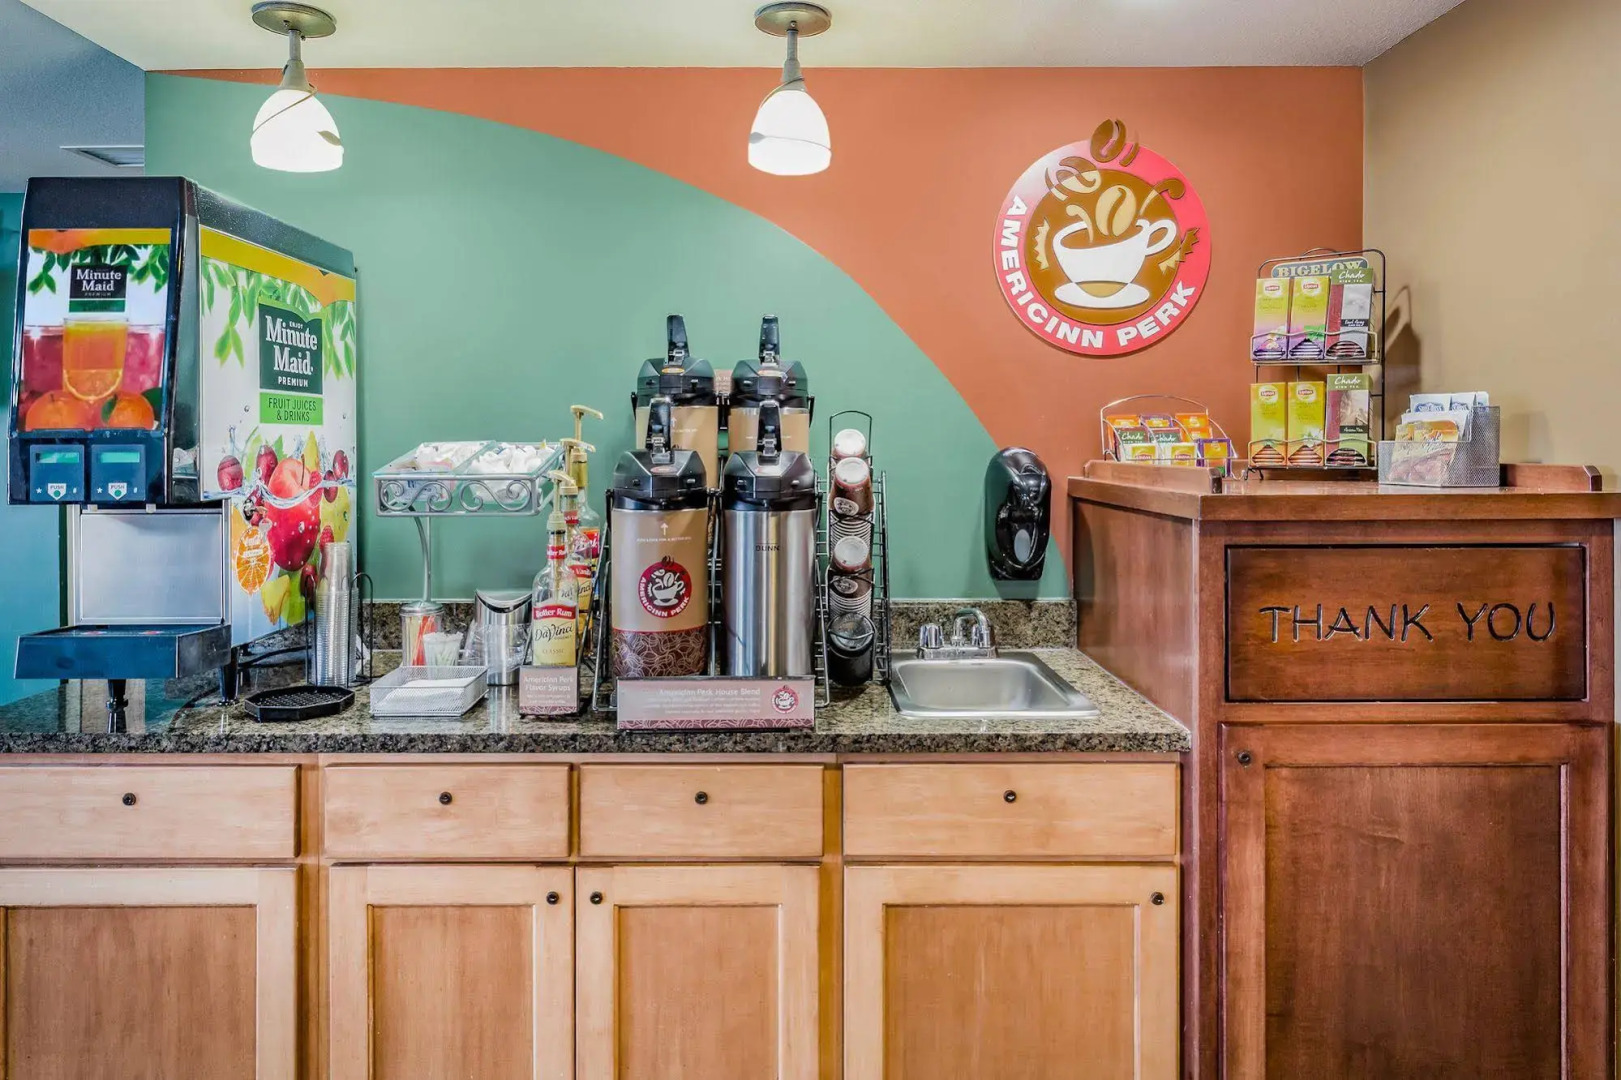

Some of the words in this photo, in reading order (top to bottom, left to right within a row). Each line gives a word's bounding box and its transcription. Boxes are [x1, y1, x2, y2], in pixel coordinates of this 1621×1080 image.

[76, 268, 122, 280] Minute
[1000, 195, 1104, 348] AMERICINN
[1116, 280, 1196, 347] PERK
[82, 280, 115, 291] Maid
[265, 315, 318, 351] Minute
[273, 345, 313, 375] Maid
[277, 376, 309, 387] PREMIUM
[268, 397, 291, 409] FRUIT
[292, 399, 317, 411] JUICES
[276, 410, 282, 421] &
[283, 410, 310, 422] DRINKS
[638, 576, 668, 617] AMERICINN
[670, 596, 690, 616] PERK
[557, 608, 573, 617] Rum
[1258, 603, 1433, 643] THANK
[1456, 602, 1556, 642] YOU
[535, 622, 573, 642] DaVinci
[715, 688, 739, 696] House
